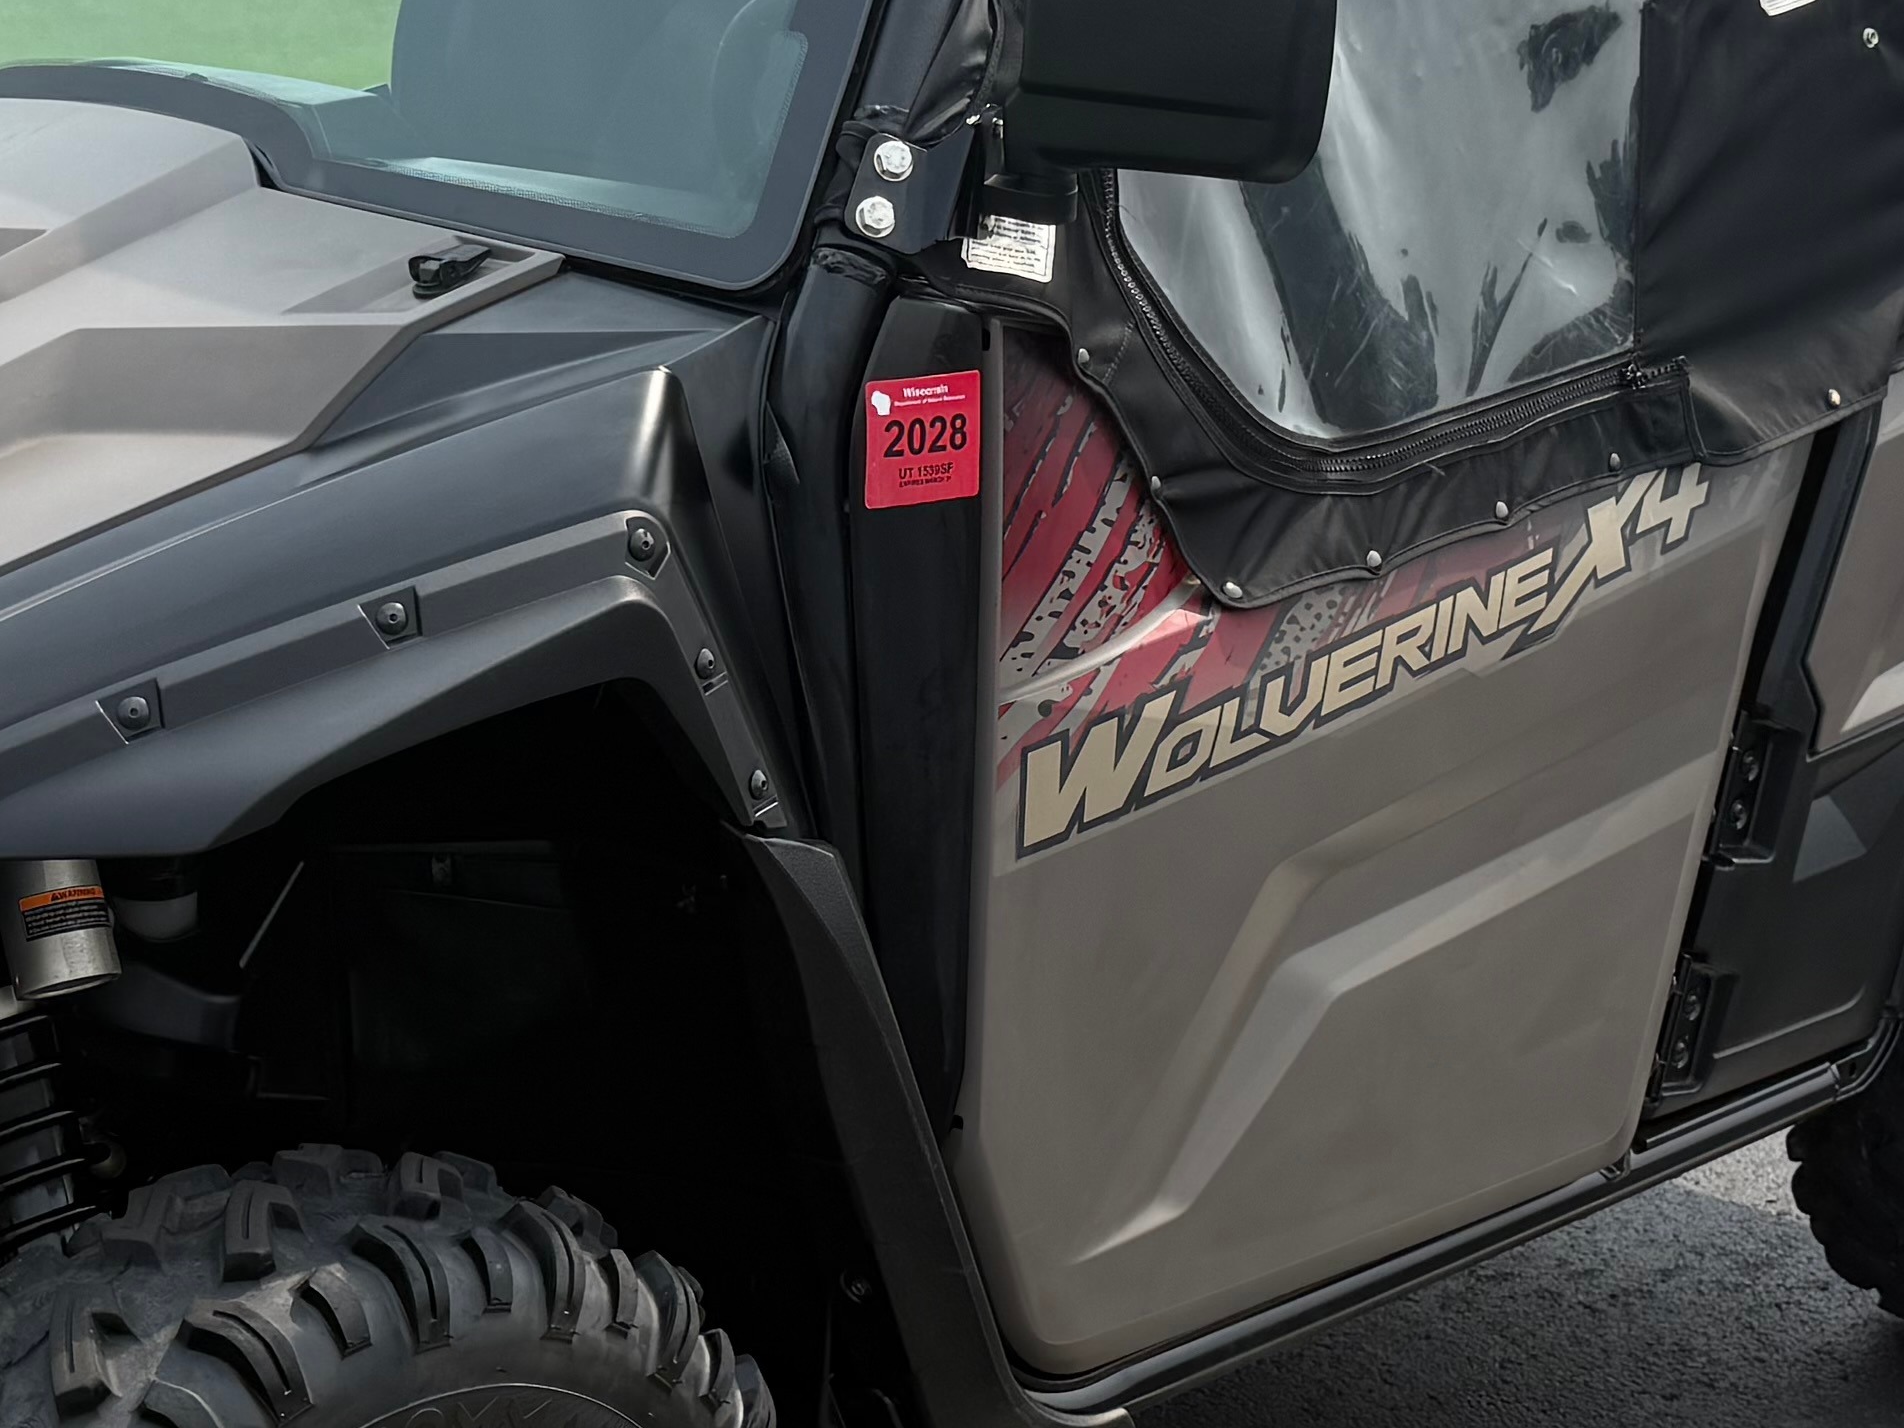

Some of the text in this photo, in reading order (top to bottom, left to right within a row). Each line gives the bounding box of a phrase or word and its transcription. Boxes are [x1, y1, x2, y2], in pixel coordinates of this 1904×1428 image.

[883, 412, 968, 458] 2028
[898, 467, 914, 479] UT
[1016, 462, 1711, 856] WOLVERINE X4
